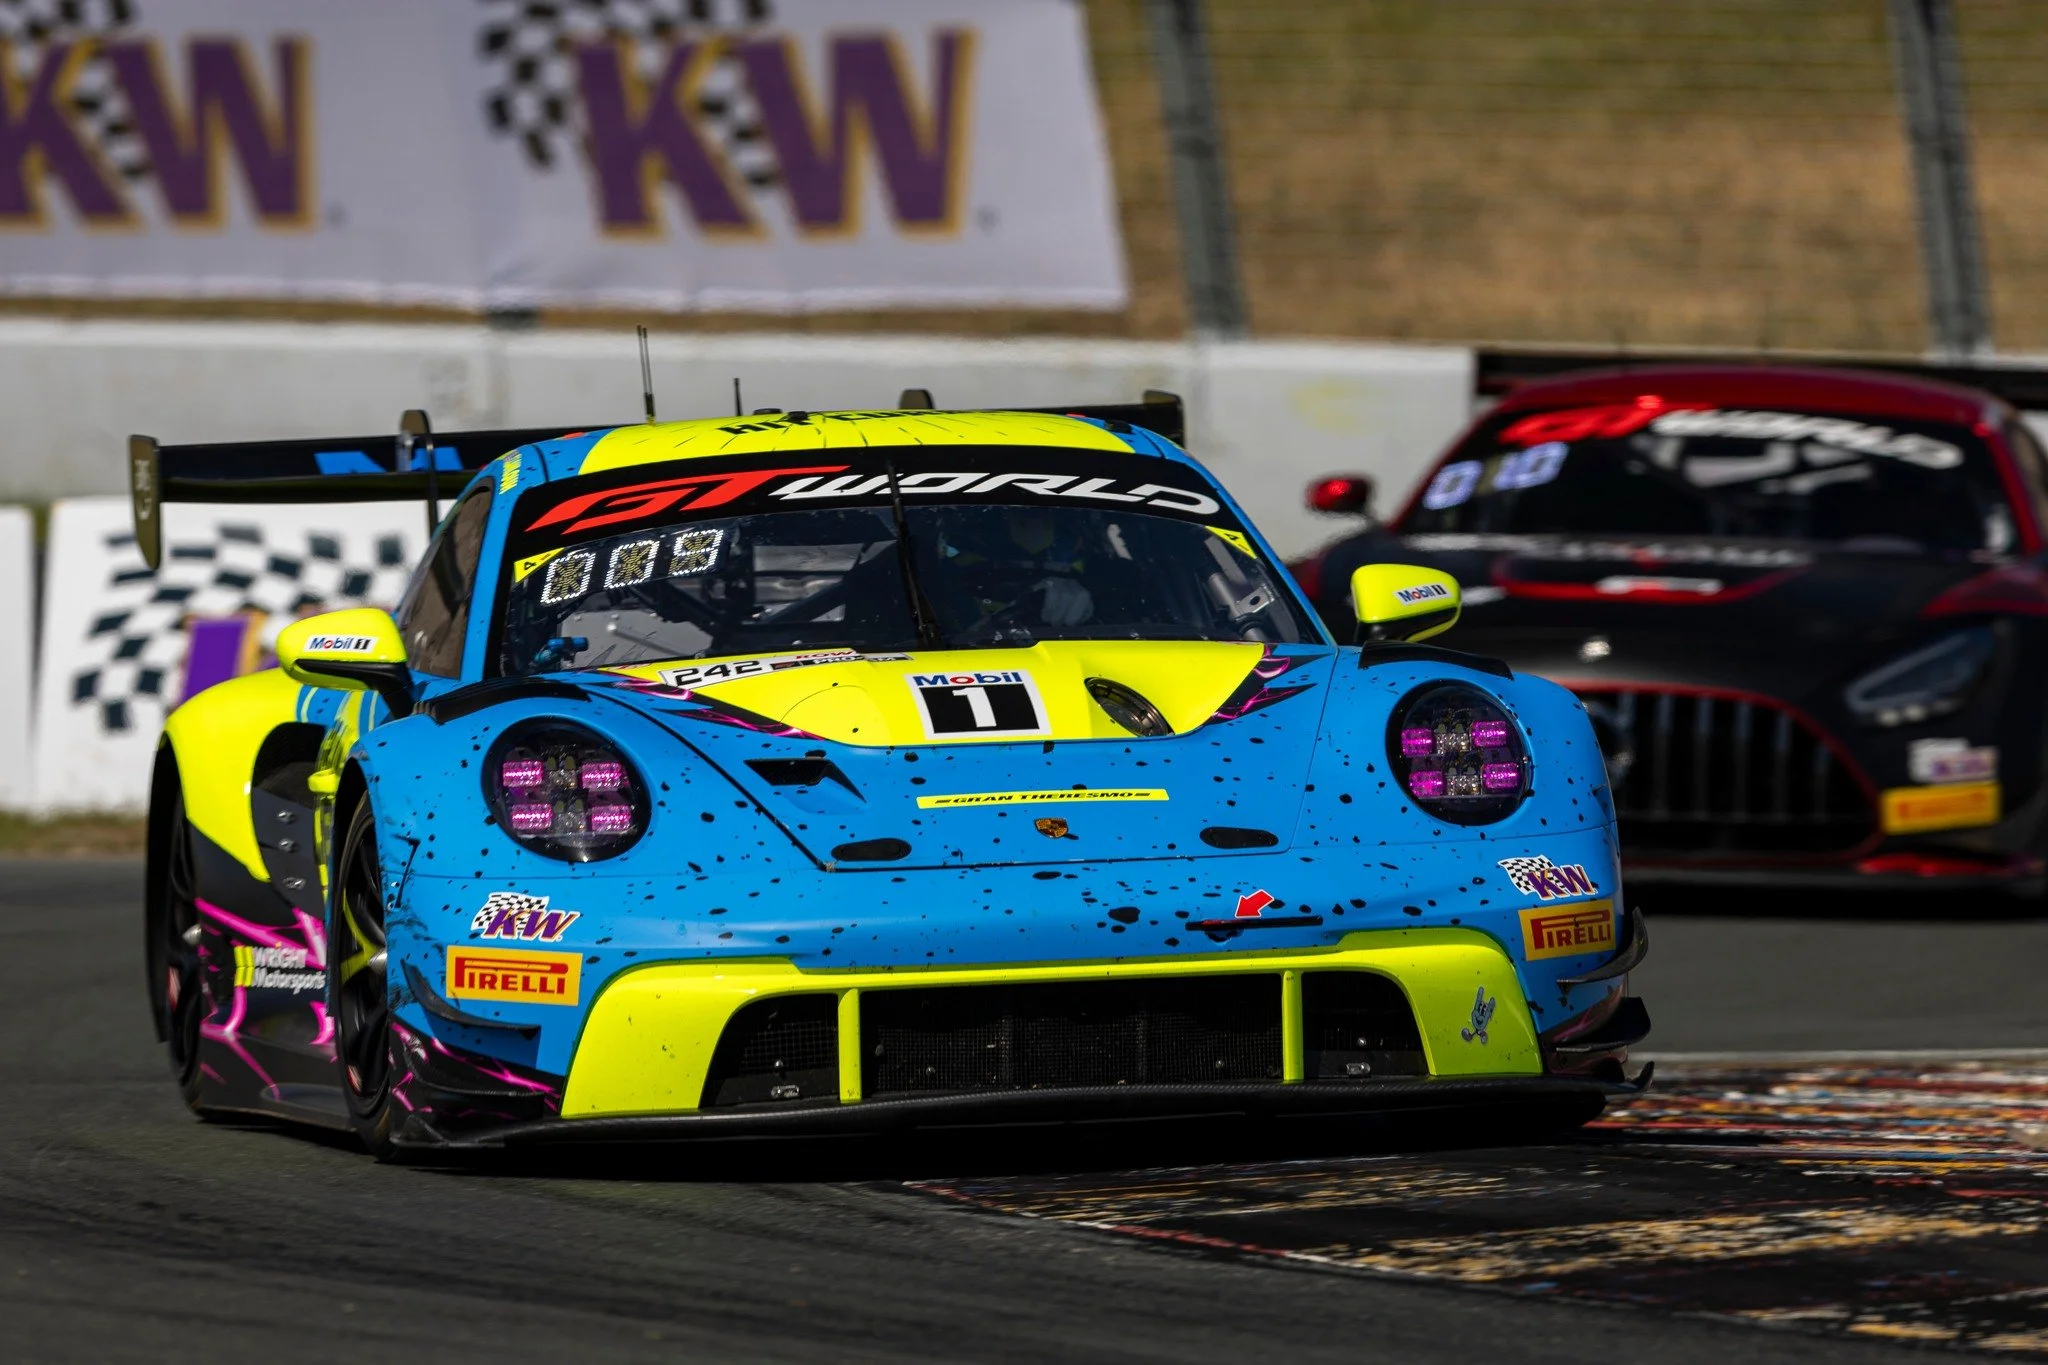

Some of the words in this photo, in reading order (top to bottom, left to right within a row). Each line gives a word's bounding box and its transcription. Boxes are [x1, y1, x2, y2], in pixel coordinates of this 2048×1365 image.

[570, 27, 977, 244] KW
[524, 465, 851, 534] GT
[768, 472, 1219, 514] WORLD
[1397, 586, 1436, 602] Mobil
[309, 637, 354, 650] Mobil
[672, 660, 763, 687] 242
[912, 671, 1023, 687] Mobil
[952, 686, 998, 728] 1
[953, 794, 1014, 804] GRAN
[1526, 865, 1595, 898] KW
[484, 908, 579, 939] KW
[1530, 909, 1611, 950] PIRELLI
[455, 956, 569, 995] PIRELLI
